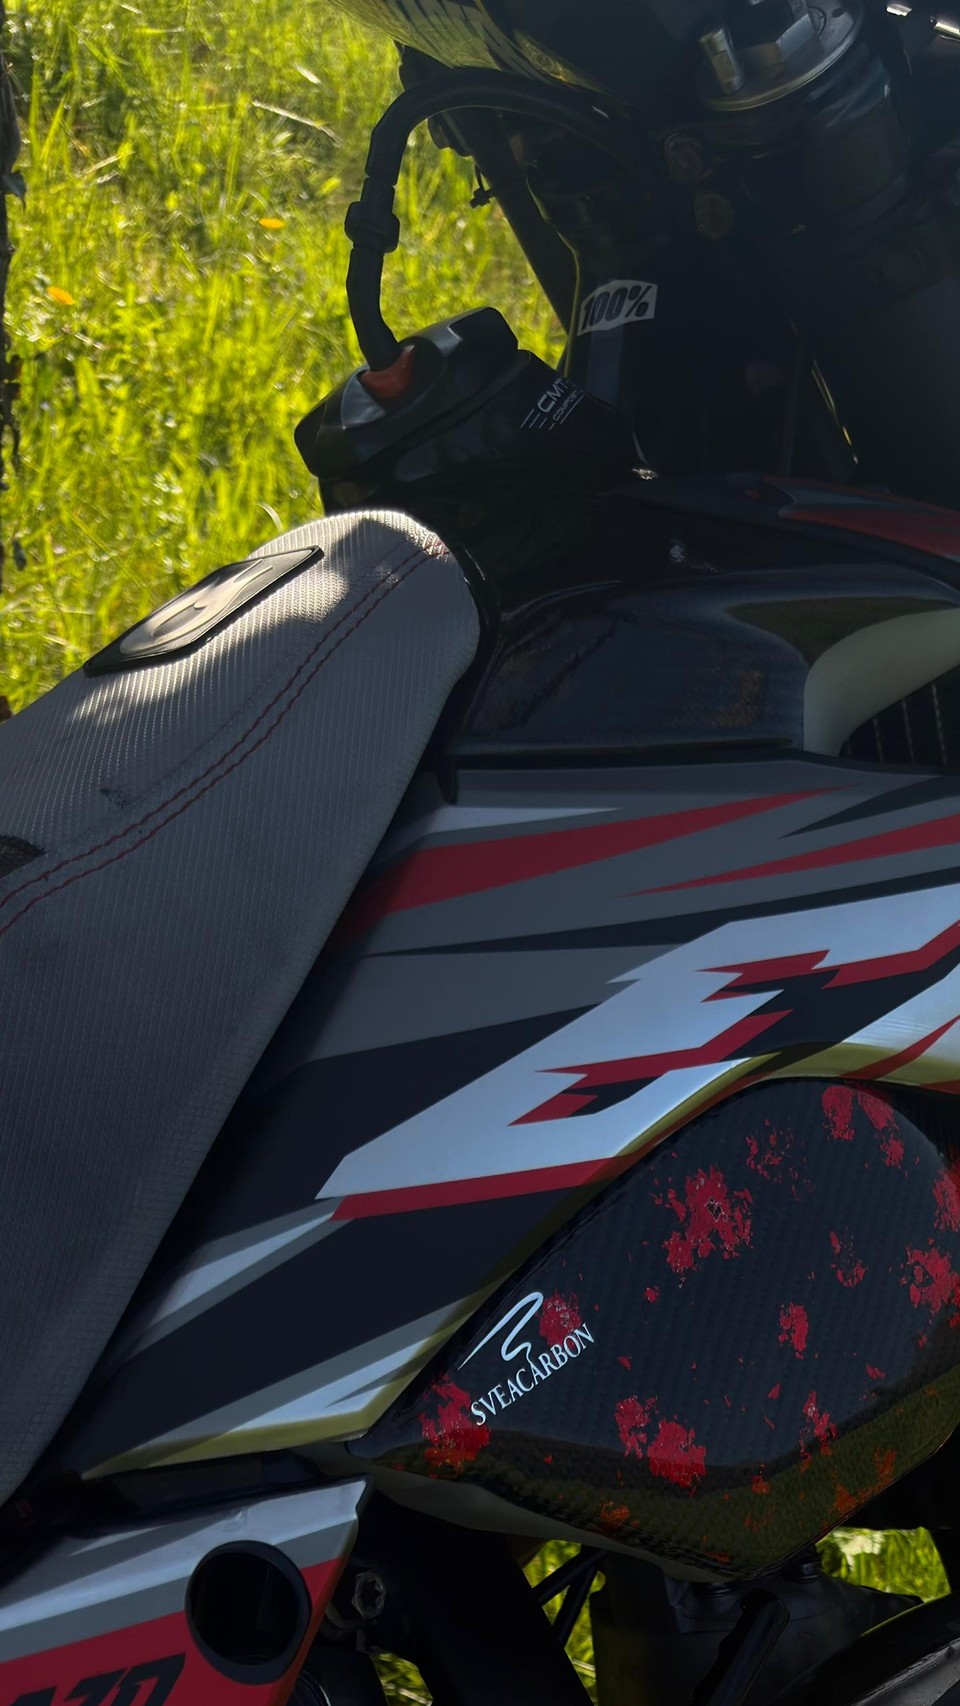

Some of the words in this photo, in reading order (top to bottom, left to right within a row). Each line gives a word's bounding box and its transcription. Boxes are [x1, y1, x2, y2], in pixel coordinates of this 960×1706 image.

[580, 284, 653, 331] 100%
[536, 377, 569, 413] CMT
[470, 1322, 595, 1426] SVEACARBON
